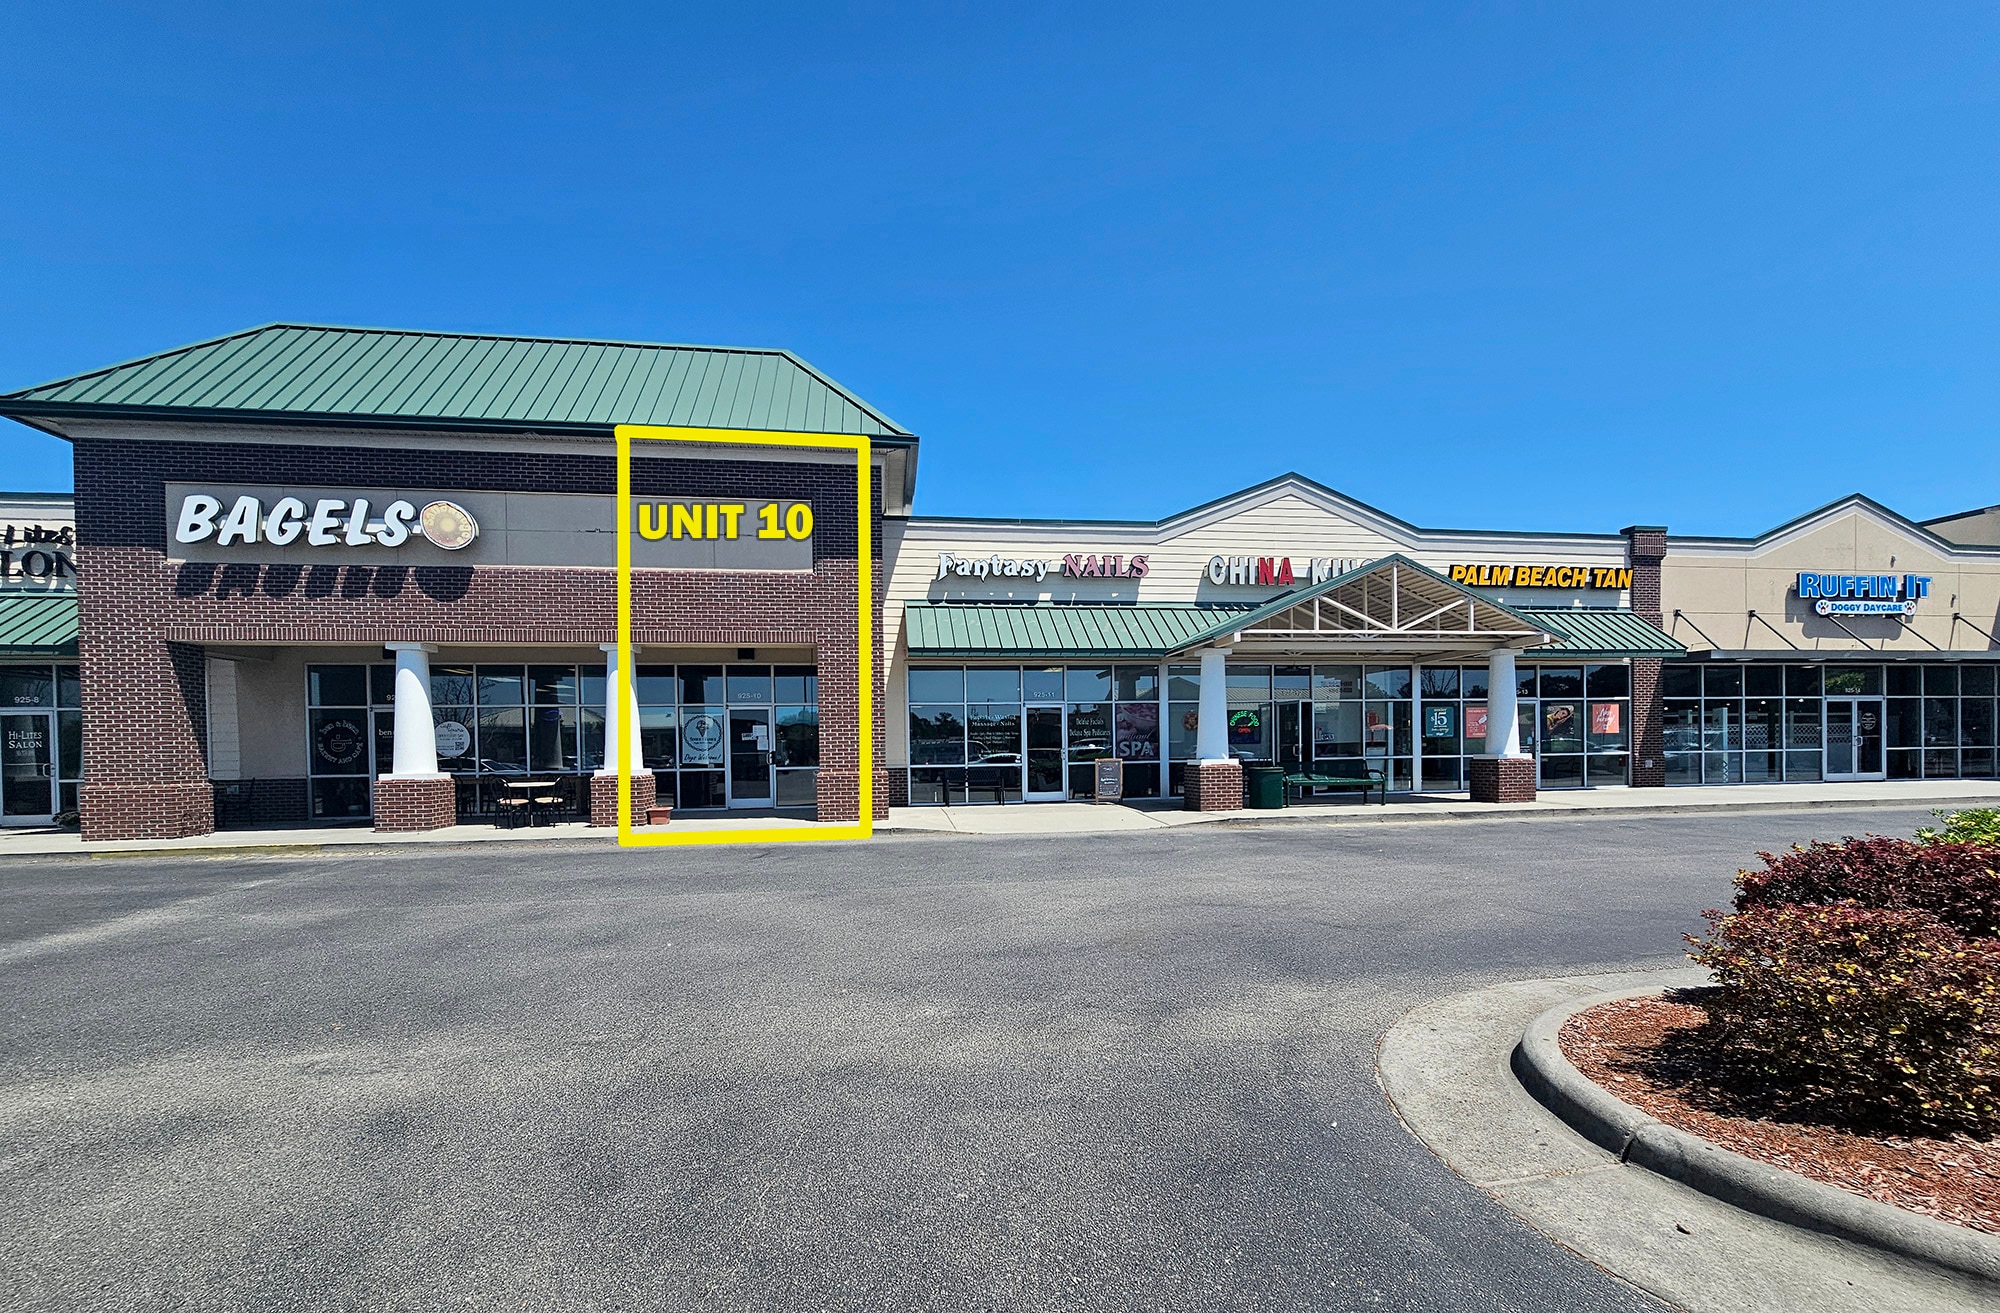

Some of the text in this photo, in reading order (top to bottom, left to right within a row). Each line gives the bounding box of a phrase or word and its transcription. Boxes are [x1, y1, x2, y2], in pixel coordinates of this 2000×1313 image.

[175, 494, 415, 547] BAGELS
[937, 552, 1150, 583] Fantasy NAILS
[1208, 555, 1376, 586] CHINA KIN
[1451, 565, 1634, 589] PALM BEACH TAN
[1799, 572, 1899, 599] RUFFIN
[1831, 603, 1903, 613] DOGGY DAYCARE
[14, 696, 40, 704] 925-8
[1430, 711, 1448, 726] $15
[1120, 741, 1154, 757] SPA
